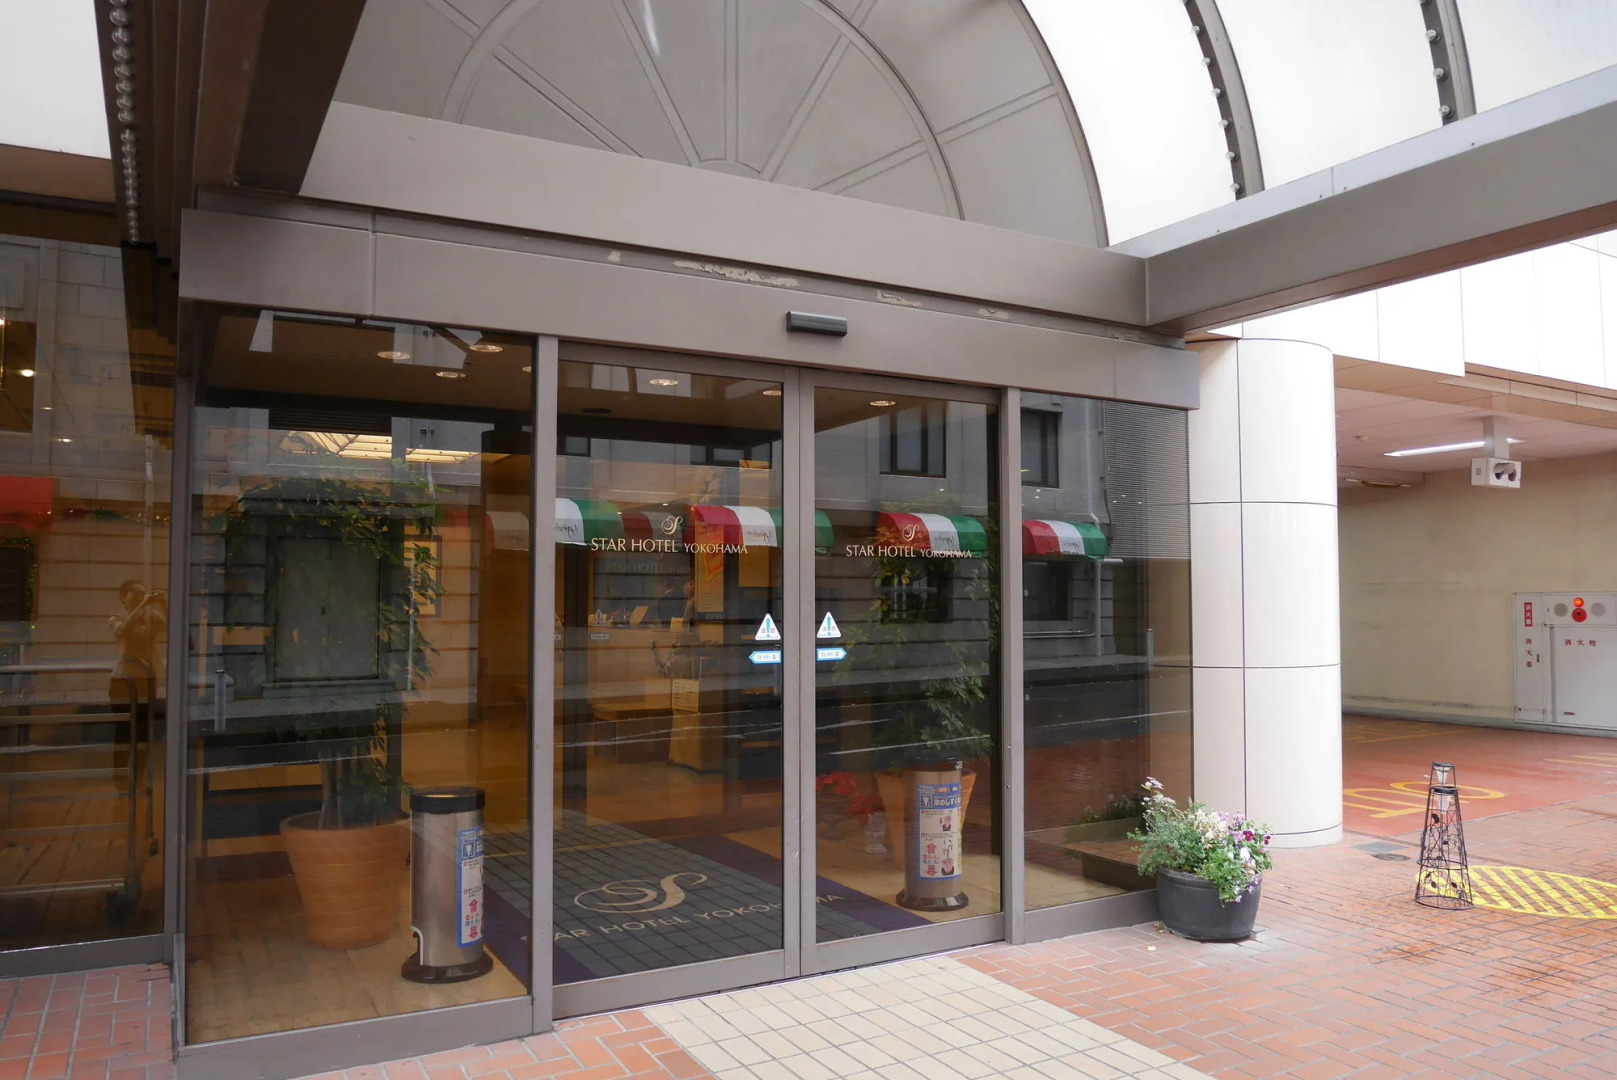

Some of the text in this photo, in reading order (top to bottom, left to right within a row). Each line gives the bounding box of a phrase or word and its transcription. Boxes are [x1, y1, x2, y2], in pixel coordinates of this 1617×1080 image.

[591, 538, 748, 554] STAR HOTEL YOKOHAMA
[846, 545, 972, 559] STAR HOTEL YOKOHAMA
[602, 914, 689, 934] HOTEL
